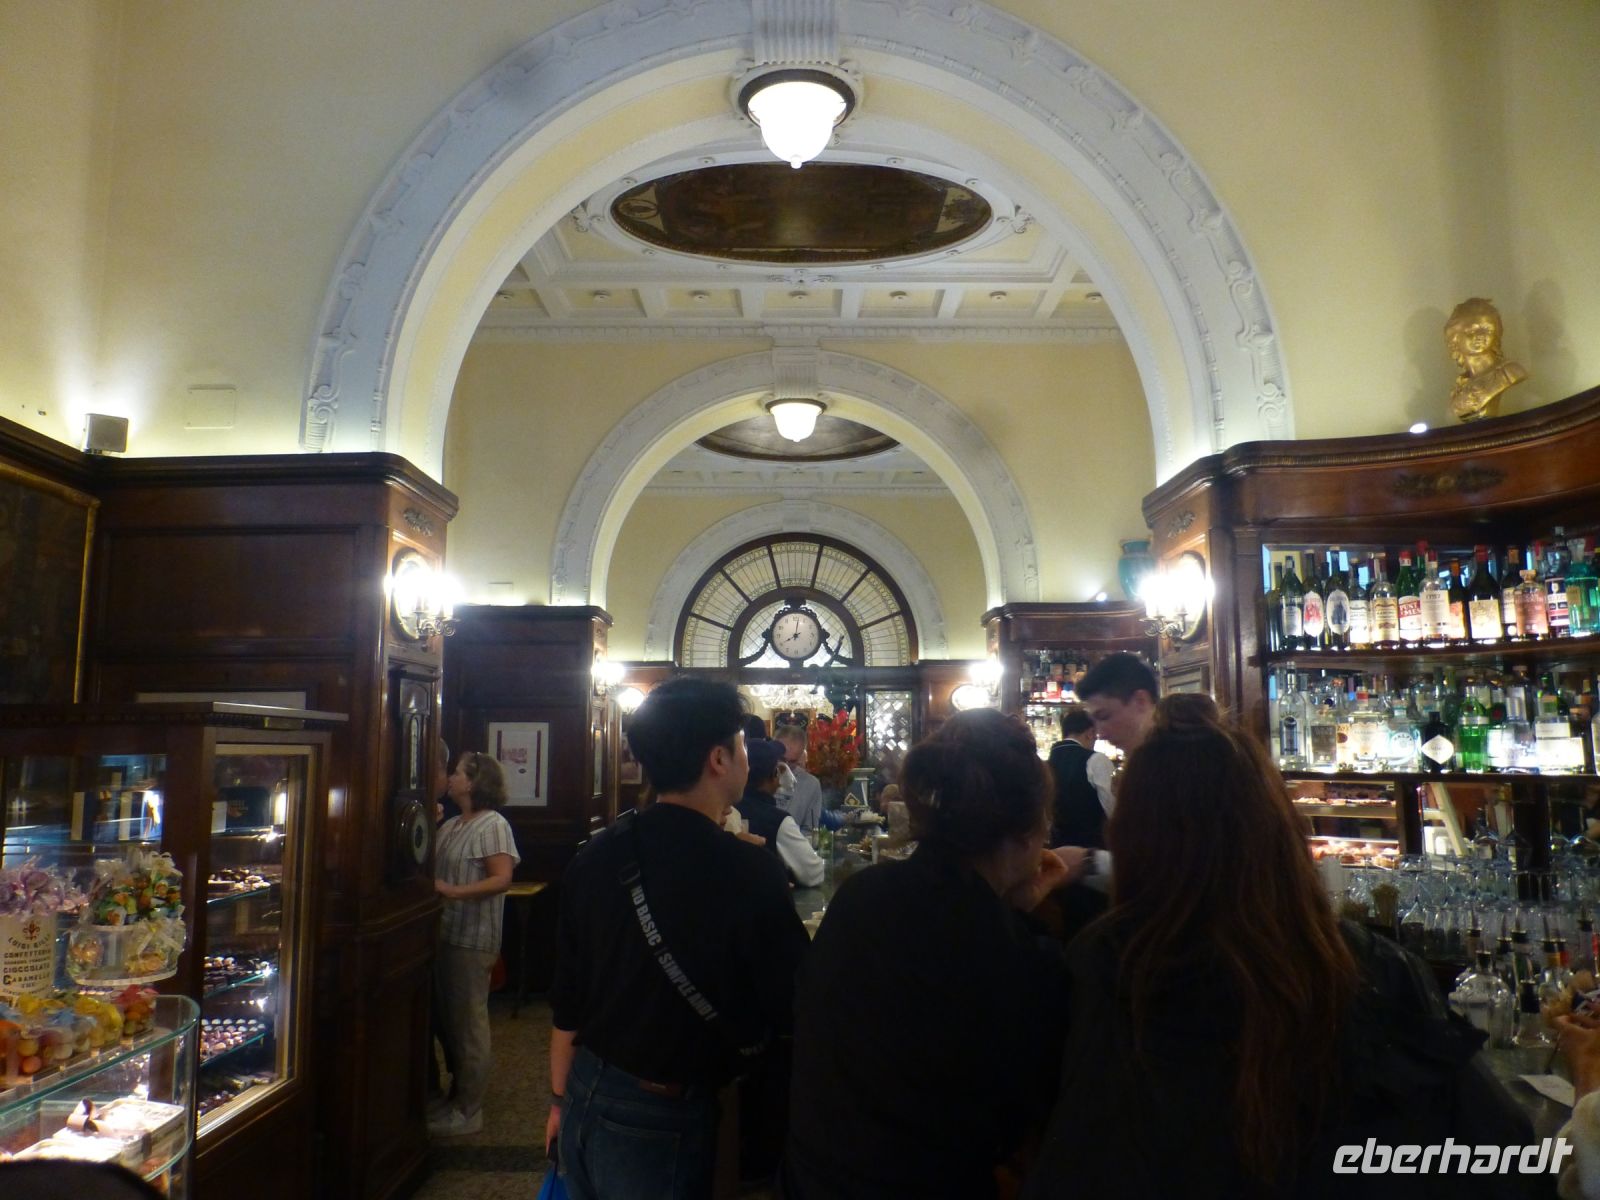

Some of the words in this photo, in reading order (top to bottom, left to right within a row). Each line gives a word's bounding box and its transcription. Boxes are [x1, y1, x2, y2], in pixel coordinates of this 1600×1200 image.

[8, 937, 30, 949] LUIGI
[636, 903, 663, 946] BASIC
[658, 952, 697, 997] SIMPLE
[687, 992, 714, 1016] AND
